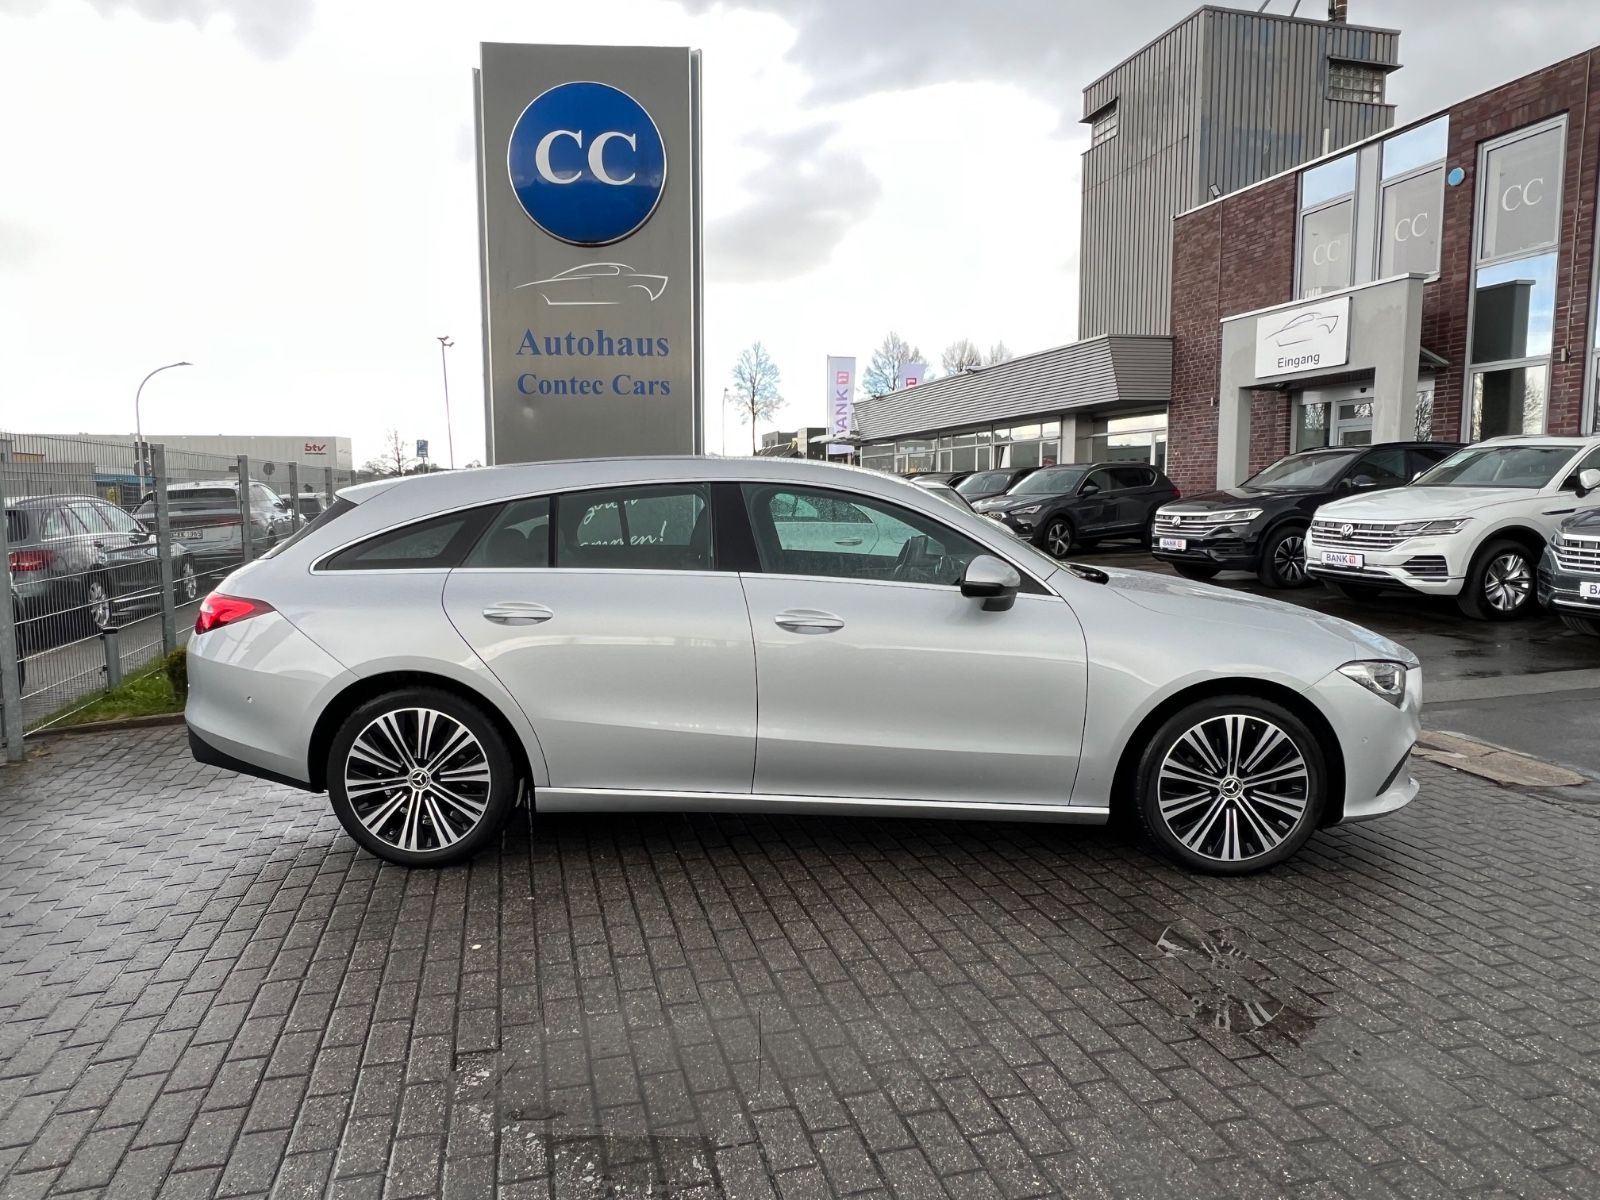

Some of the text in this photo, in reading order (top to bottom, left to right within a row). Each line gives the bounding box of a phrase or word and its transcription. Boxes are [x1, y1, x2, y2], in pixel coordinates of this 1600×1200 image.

[535, 129, 636, 186] CC
[1502, 178, 1543, 212] CC
[1395, 212, 1428, 242] CC
[1312, 239, 1341, 266] CC
[516, 328, 670, 357] Autohaus
[1277, 353, 1320, 369] Eingang
[517, 373, 671, 397] Contec Cars
[304, 443, 327, 452] btv
[1326, 553, 1348, 563] BANK
